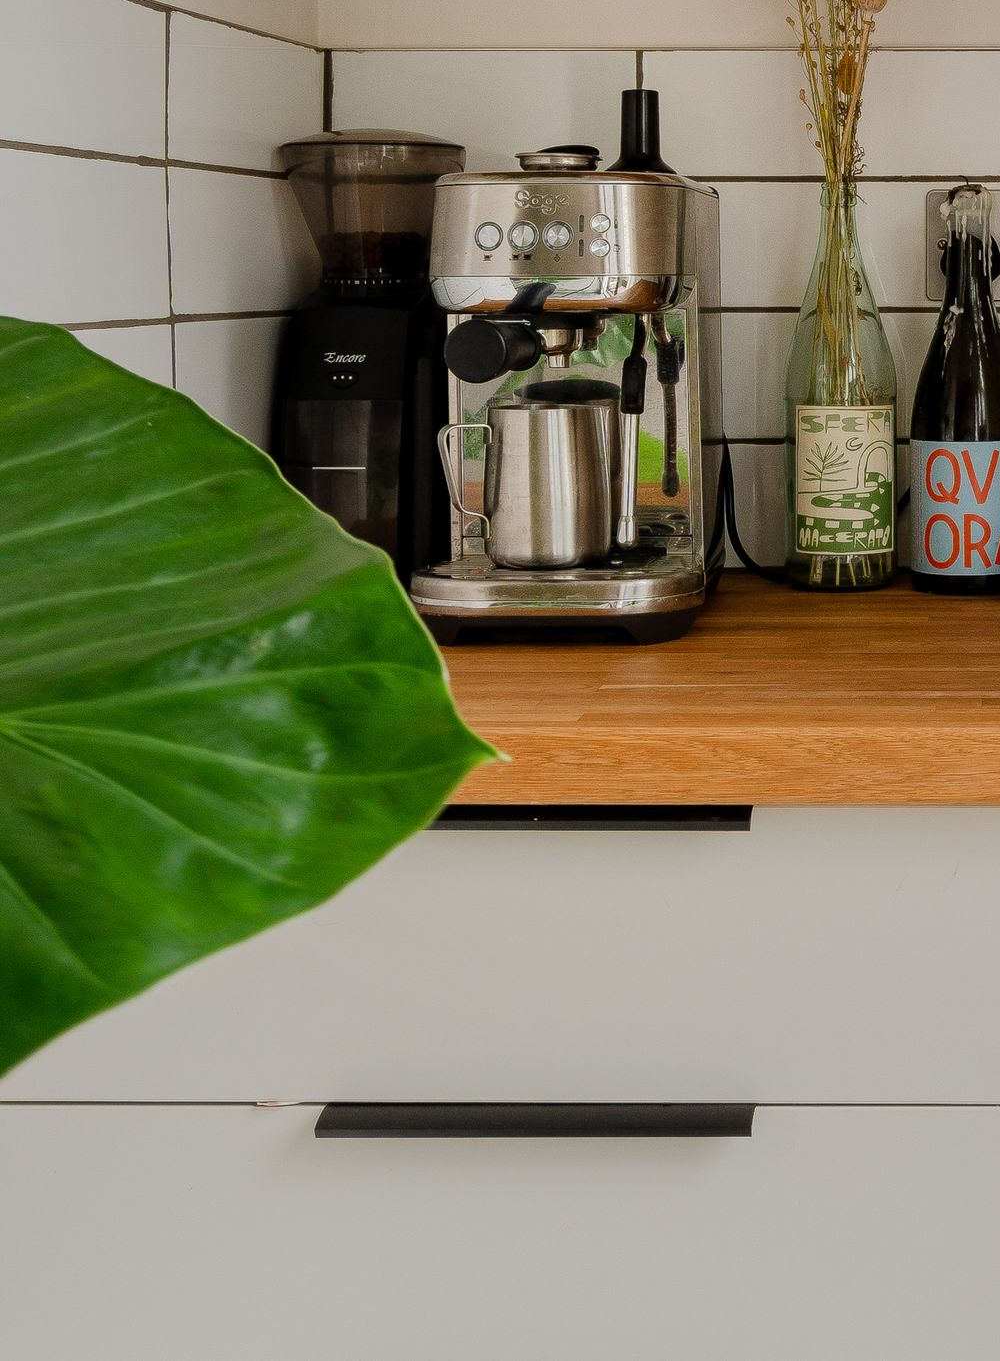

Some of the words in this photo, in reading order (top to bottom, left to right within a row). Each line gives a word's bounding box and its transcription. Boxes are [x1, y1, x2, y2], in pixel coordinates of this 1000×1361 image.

[514, 190, 571, 215] Sage
[323, 352, 367, 364] Encore
[800, 410, 891, 435] SFERA
[799, 524, 891, 549] MACERATO
